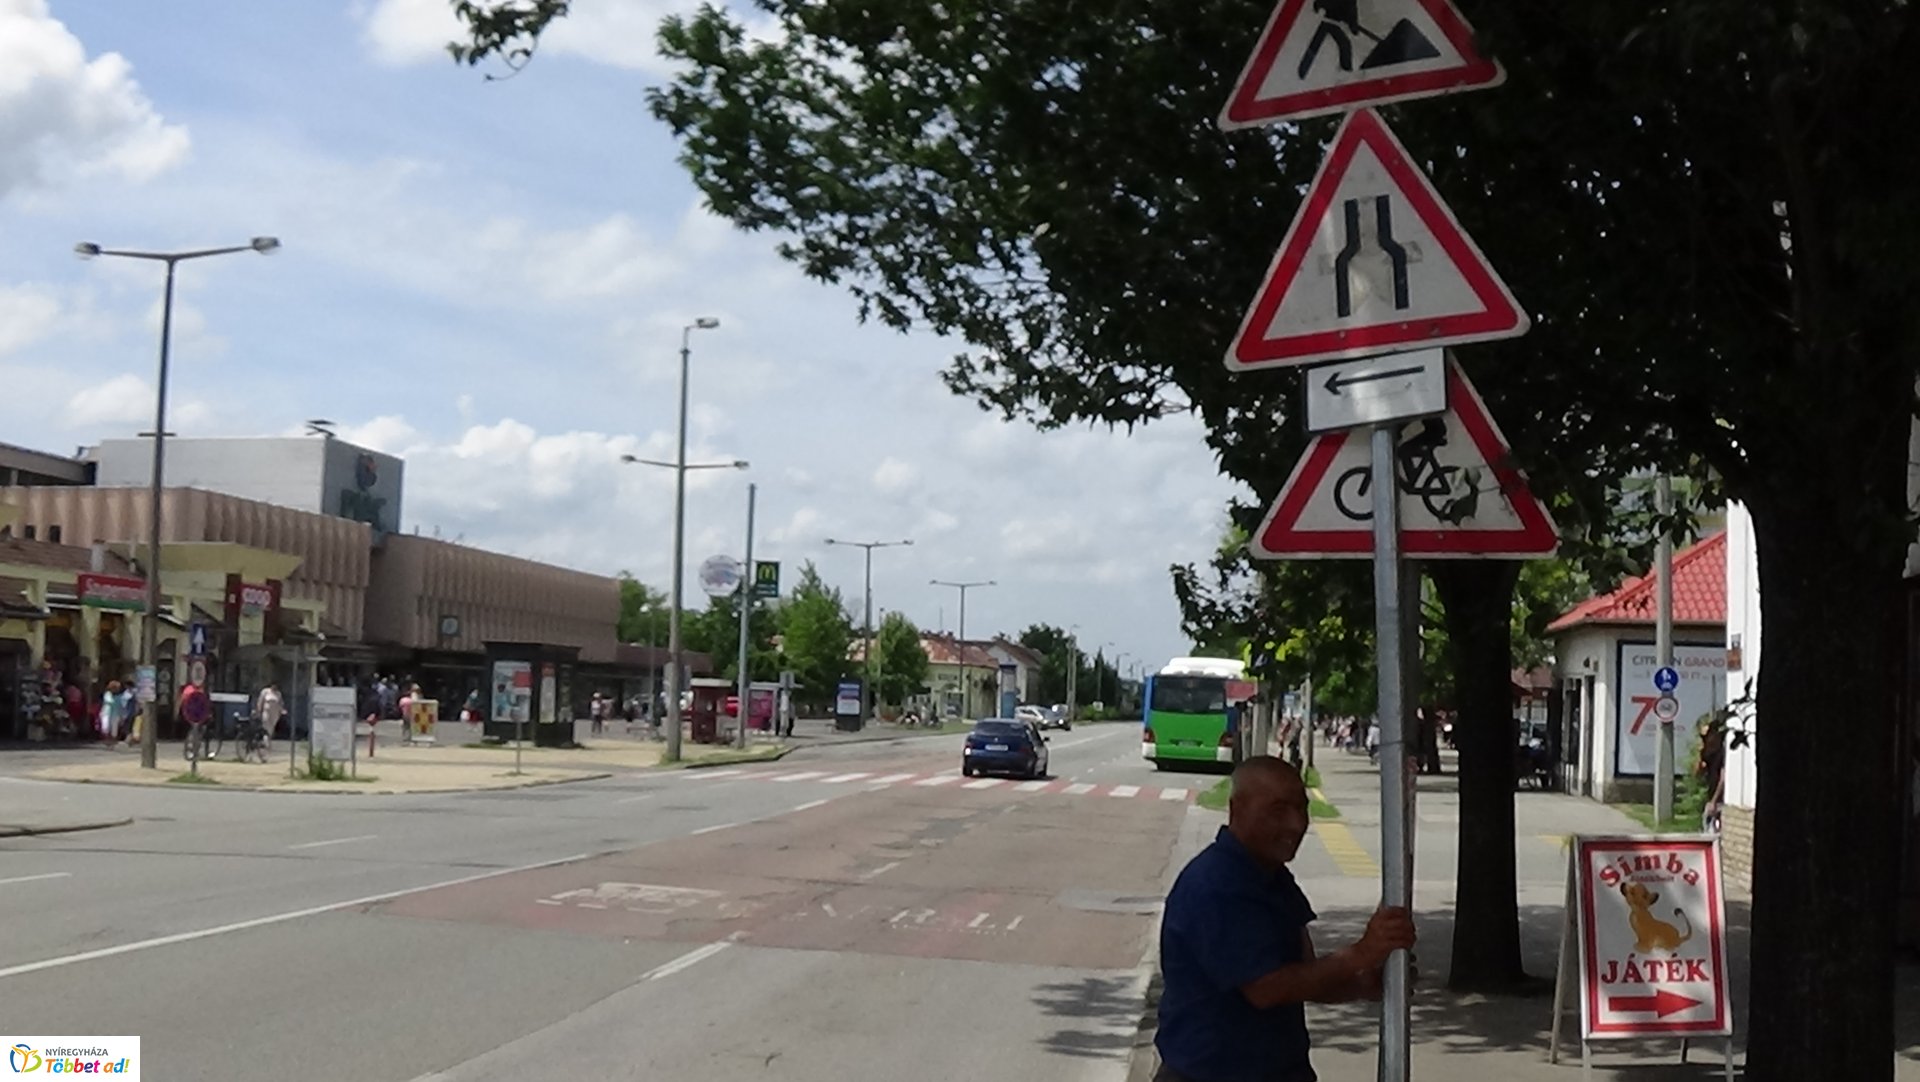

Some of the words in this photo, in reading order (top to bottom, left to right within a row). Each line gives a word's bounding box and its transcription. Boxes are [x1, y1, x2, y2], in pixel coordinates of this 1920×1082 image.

[1632, 655, 1681, 667] CITRN
[1599, 852, 1700, 887] Simba
[1601, 952, 1710, 984] JÁTÉK
